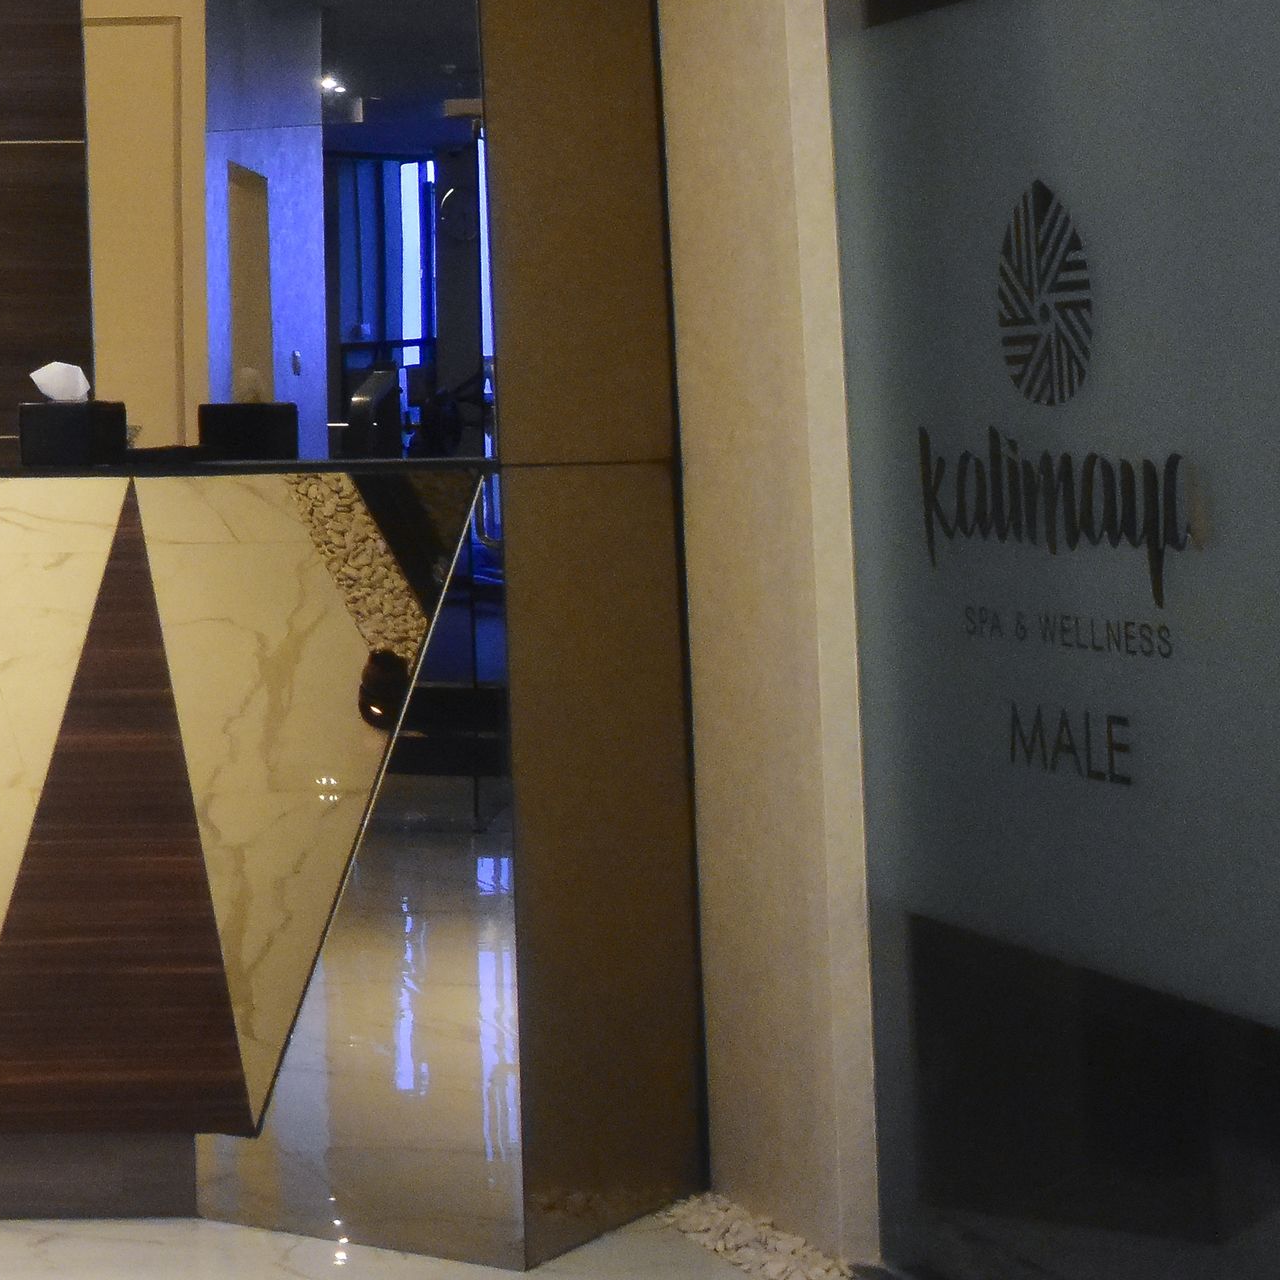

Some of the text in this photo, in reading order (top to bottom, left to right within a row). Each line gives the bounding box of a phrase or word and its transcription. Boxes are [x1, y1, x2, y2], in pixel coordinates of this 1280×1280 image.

[918, 424, 1212, 609] kalimaya
[964, 606, 1174, 659] SPA & WELLNESS
[1009, 700, 1133, 786] MALE
